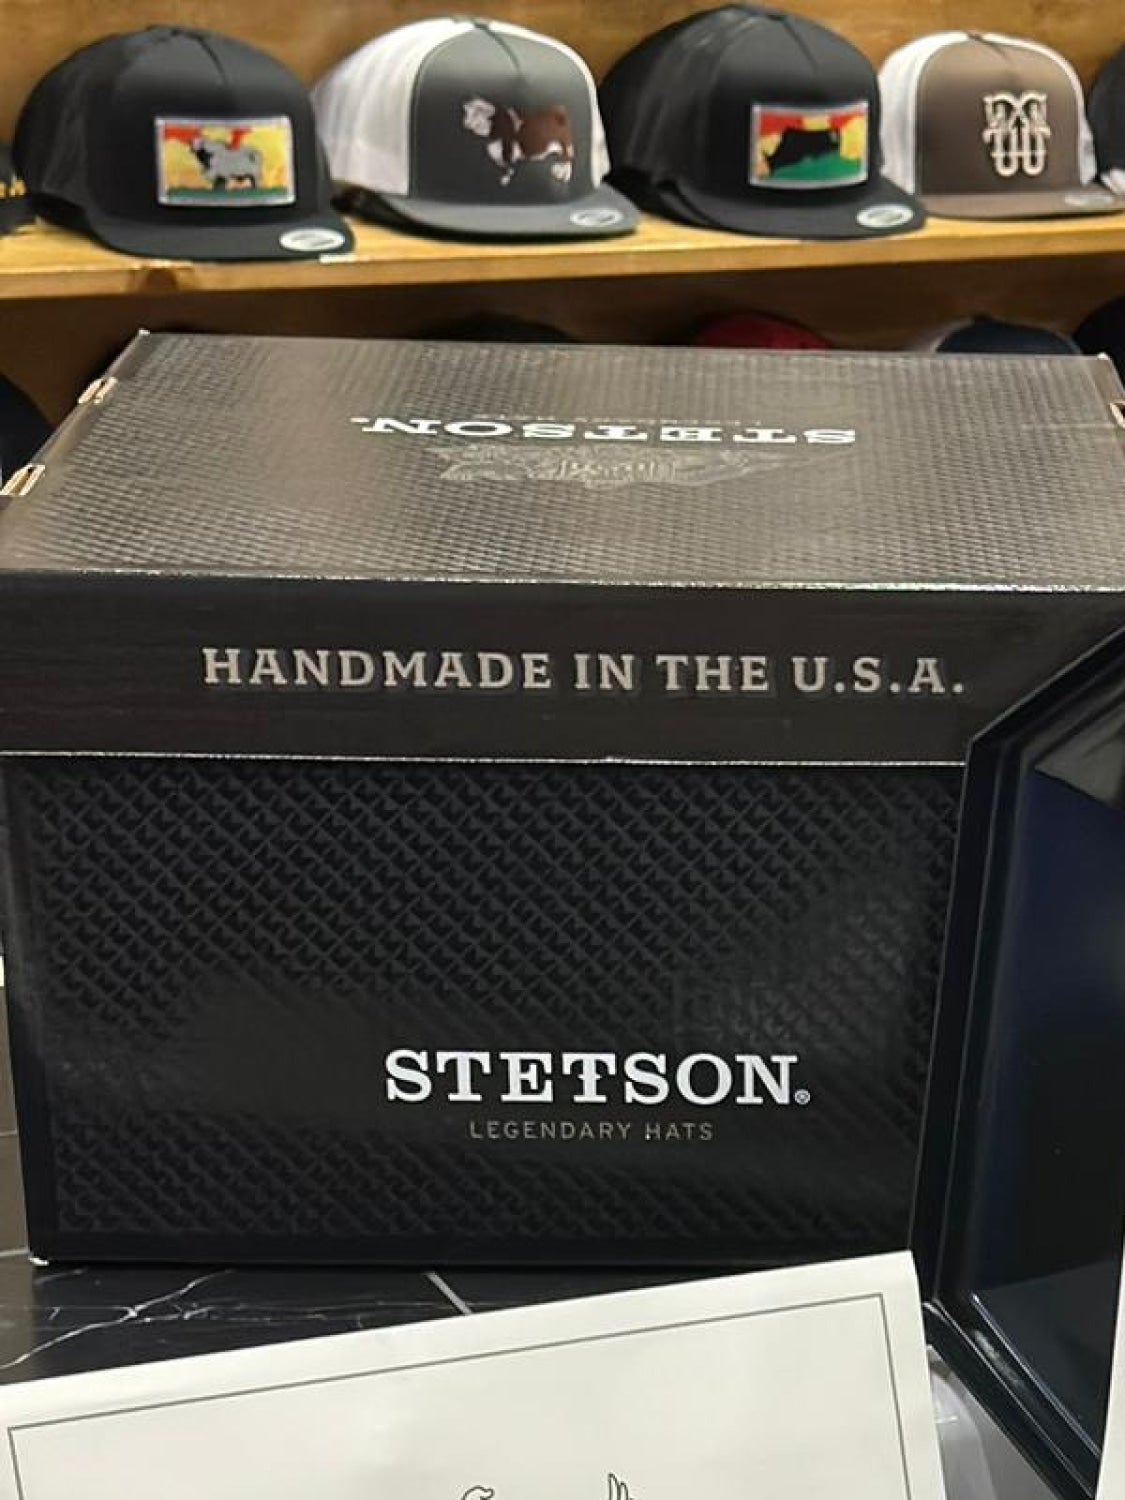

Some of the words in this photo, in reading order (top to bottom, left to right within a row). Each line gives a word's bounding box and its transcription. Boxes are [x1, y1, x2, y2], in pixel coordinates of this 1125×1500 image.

[202, 648, 553, 689] HANDMADE
[574, 653, 635, 691] IN
[655, 654, 770, 691] THE
[792, 656, 965, 694] U.S.A.
[468, 1120, 632, 1141] LEGENDARY
[645, 1123, 714, 1142] HATS
